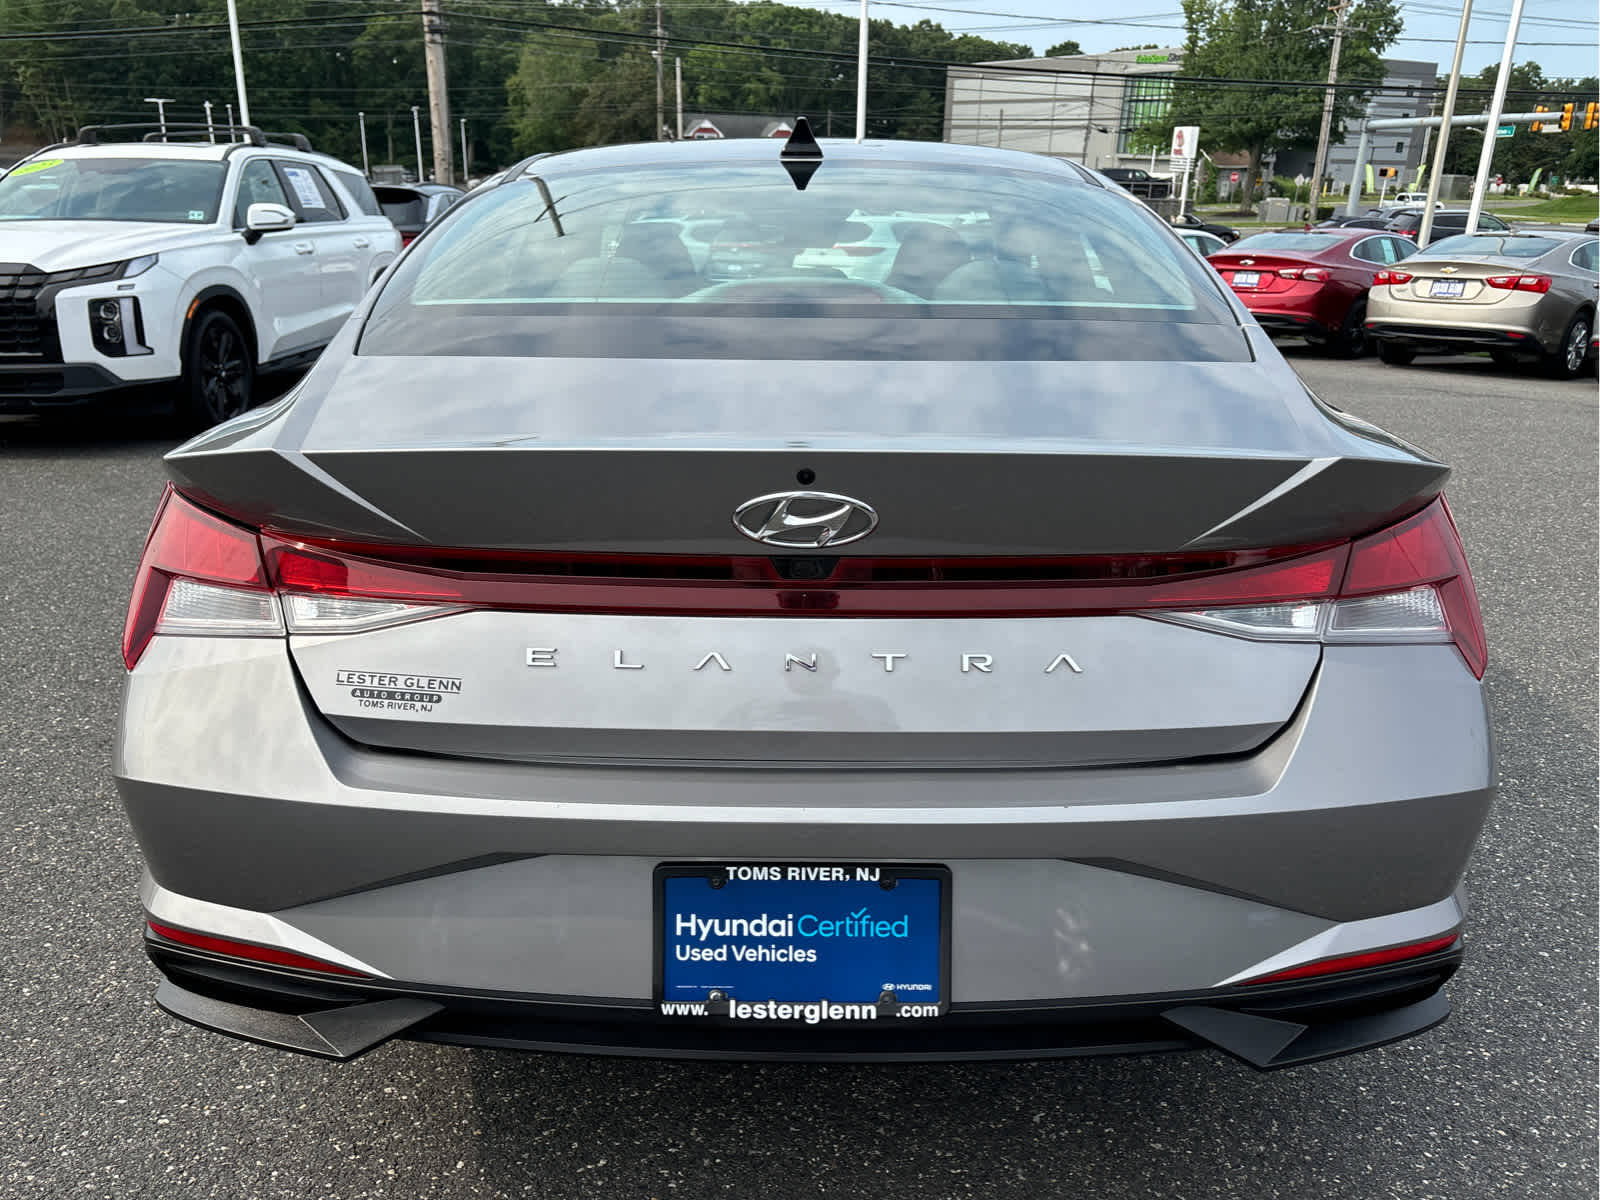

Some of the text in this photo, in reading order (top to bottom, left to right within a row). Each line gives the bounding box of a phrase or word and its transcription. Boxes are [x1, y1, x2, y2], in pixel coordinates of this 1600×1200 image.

[525, 647, 1084, 674] ELANTRA
[336, 672, 462, 692] LESTER GLENN
[354, 689, 440, 702] AUTO GROUP
[358, 699, 433, 712] TOMS RIVER, NJ
[726, 866, 881, 882] TOMS RIVER, NJ
[675, 908, 909, 942] Hyundai Certified
[675, 945, 818, 963] Used Vehicles
[896, 983, 933, 991] HYUNDAI
[661, 1003, 709, 1017] www.
[729, 1000, 877, 1024] lesterglenn
